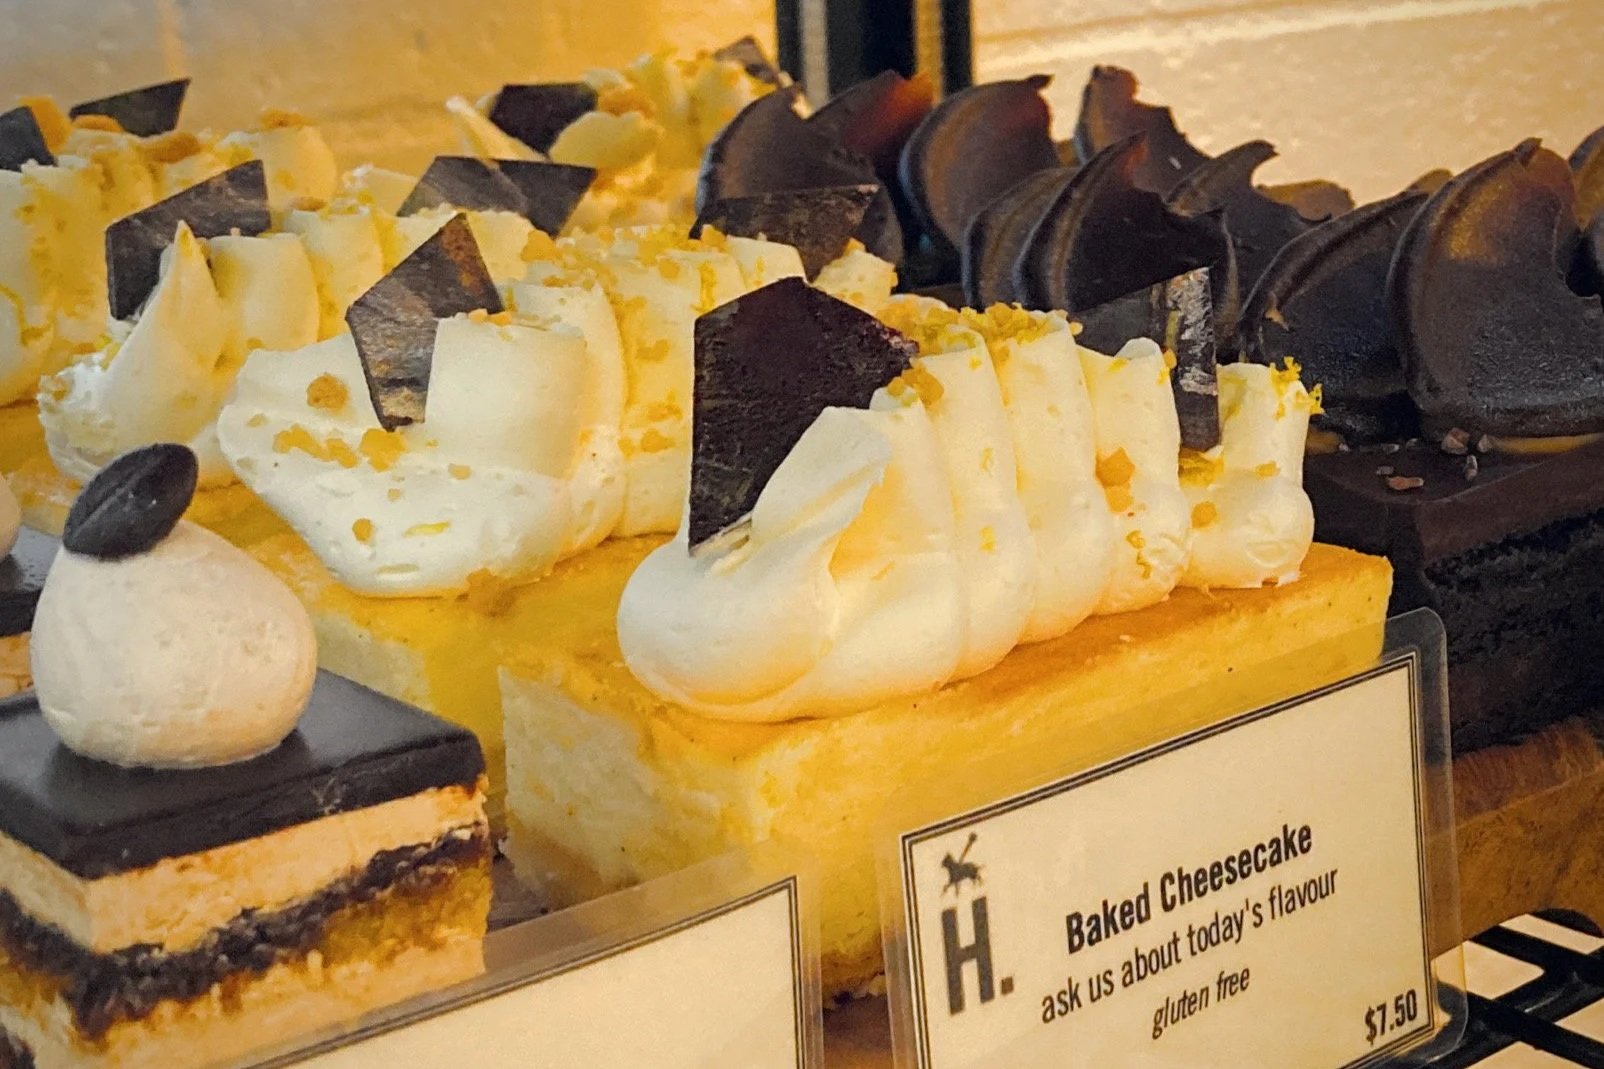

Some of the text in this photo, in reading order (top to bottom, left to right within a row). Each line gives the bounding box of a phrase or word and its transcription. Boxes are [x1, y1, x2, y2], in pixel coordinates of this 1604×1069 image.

[1065, 824, 1312, 954] Baked Cheesecake
[1041, 868, 1338, 1024] ask us about today's flavour
[1152, 967, 1250, 1040] gluten free
[1364, 989, 1418, 1044] $7.50
